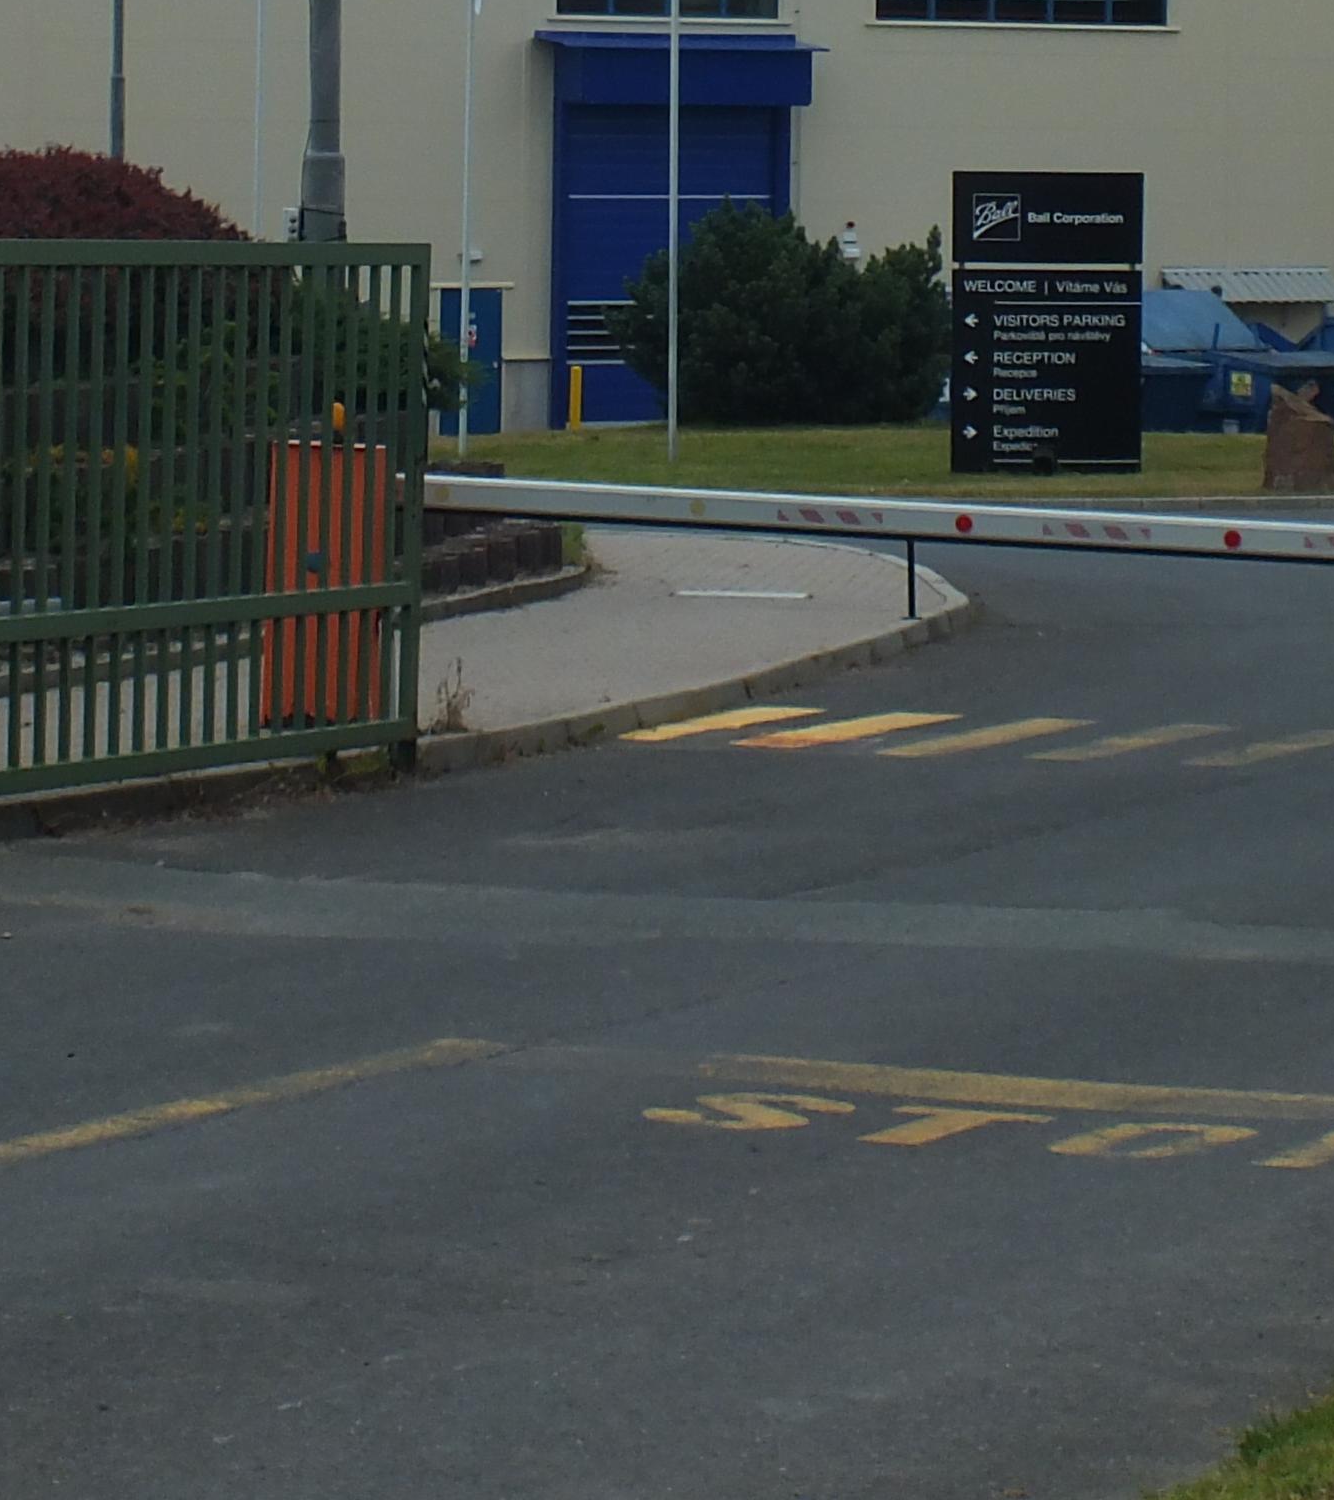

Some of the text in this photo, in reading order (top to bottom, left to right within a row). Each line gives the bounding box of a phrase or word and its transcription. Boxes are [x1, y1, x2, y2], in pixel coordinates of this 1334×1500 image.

[974, 200, 1019, 232] Ball
[1027, 211, 1125, 226] Ball Corporation
[963, 280, 1037, 293] WELCOME
[992, 314, 1127, 328] VISITORS PARKING
[992, 351, 1077, 366] RECEPTION
[992, 388, 1077, 402] DELIVERIES
[992, 424, 1060, 440] Expedition
